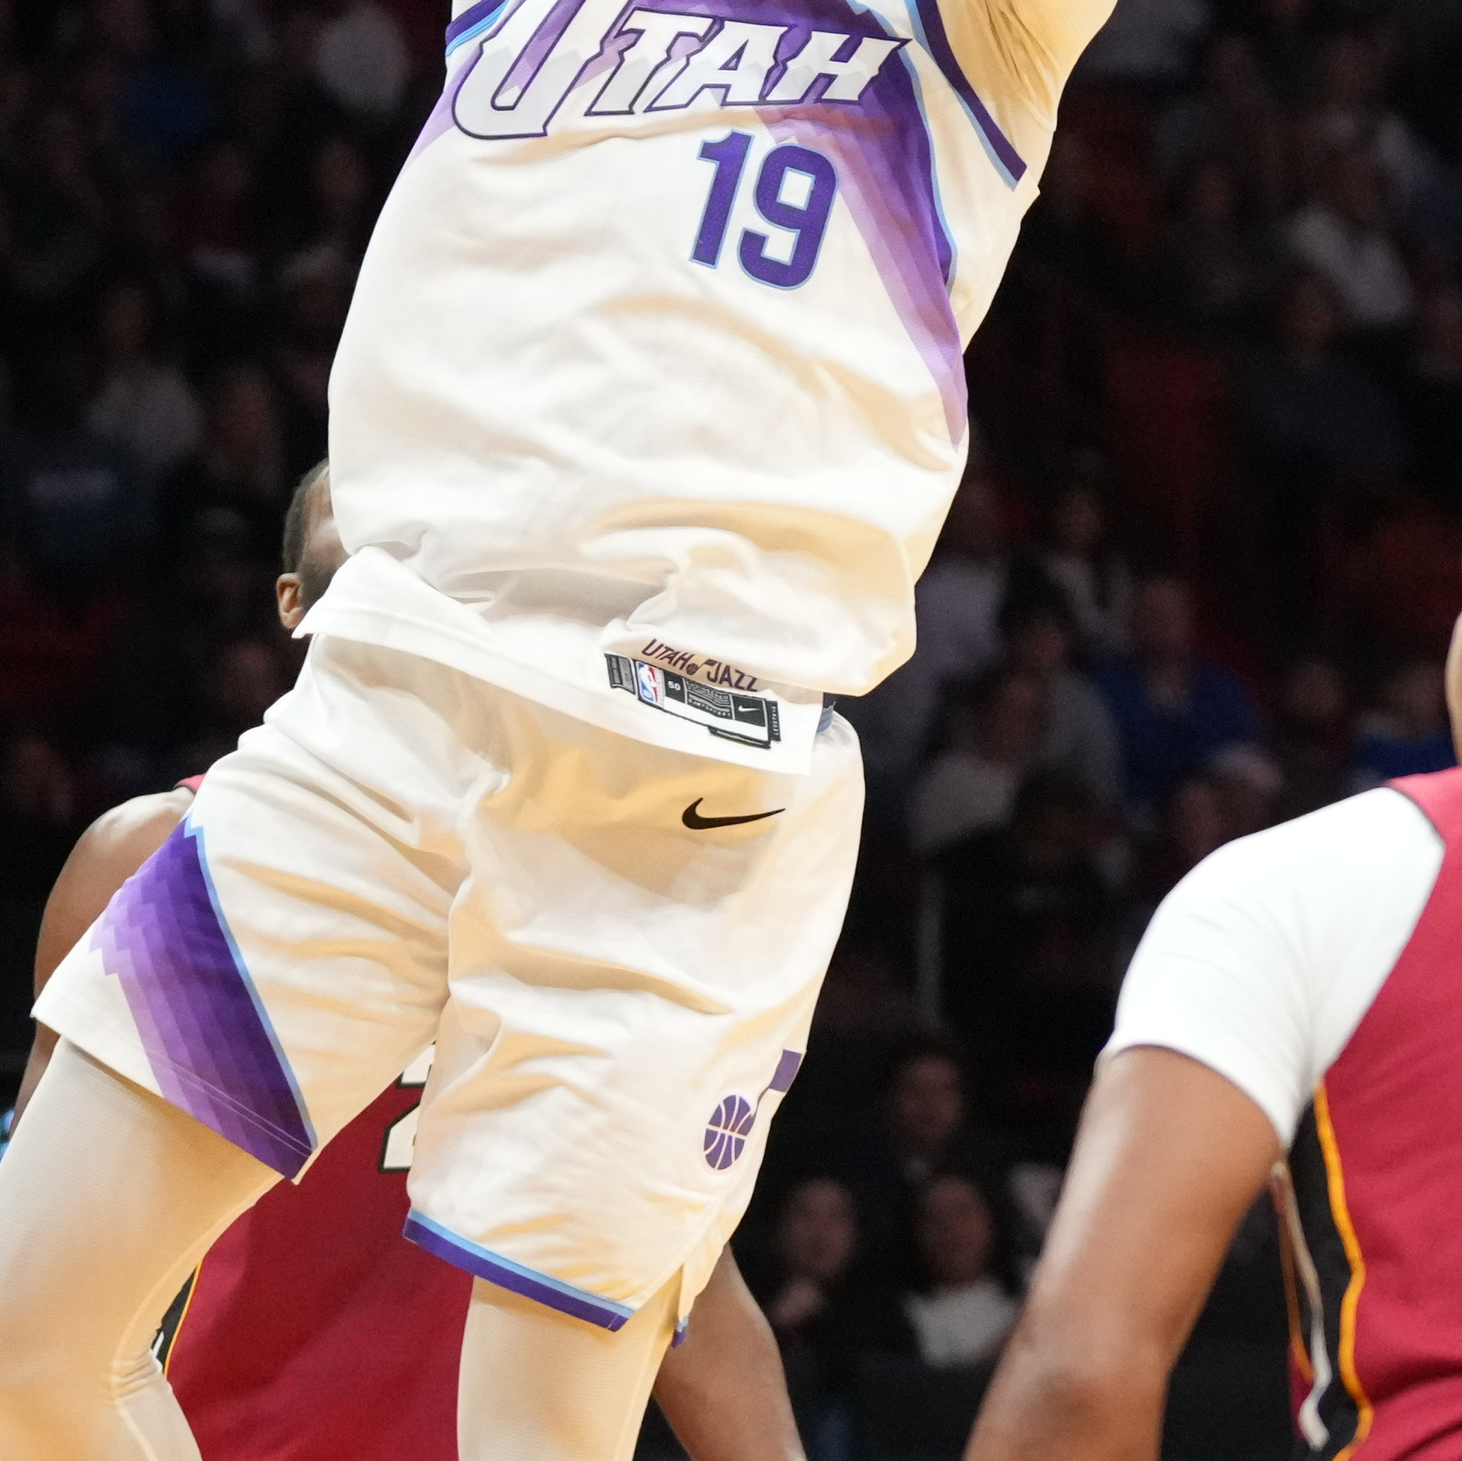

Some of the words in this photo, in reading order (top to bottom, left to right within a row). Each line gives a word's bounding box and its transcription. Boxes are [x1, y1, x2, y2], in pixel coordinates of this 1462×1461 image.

[689, 129, 837, 290] 19
[641, 638, 695, 670] UTAH
[706, 662, 758, 692] JAZZ
